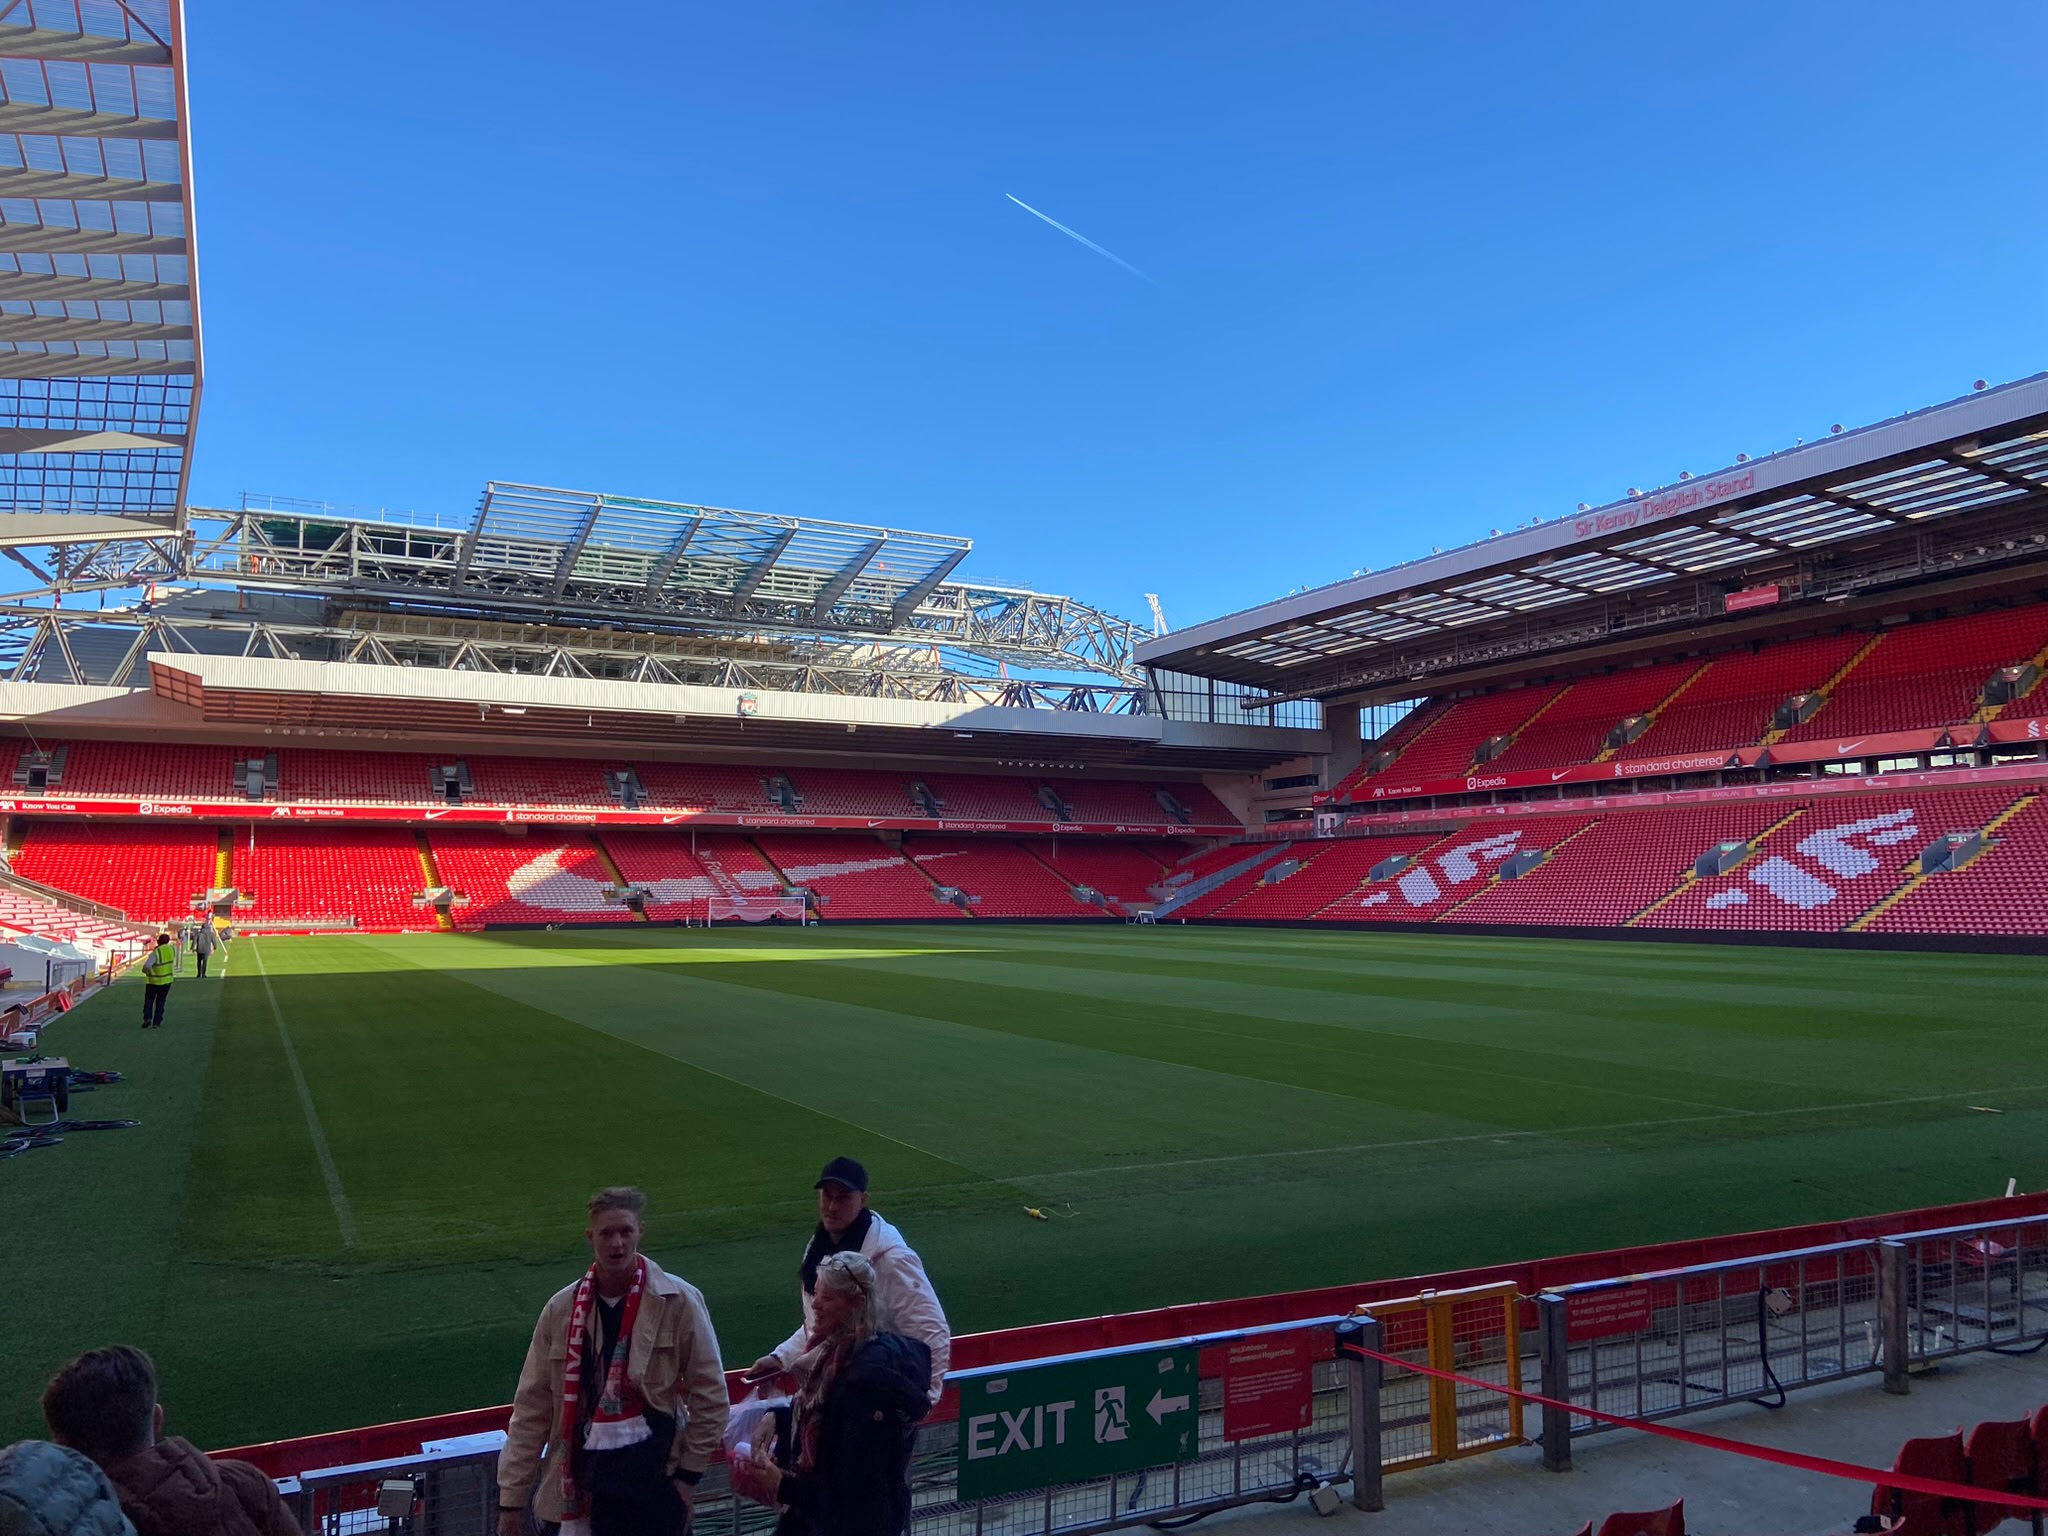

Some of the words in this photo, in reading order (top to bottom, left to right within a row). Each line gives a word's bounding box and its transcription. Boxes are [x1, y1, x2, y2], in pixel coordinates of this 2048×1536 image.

[1574, 521, 1593, 538] Sir
[1595, 508, 1641, 532] Kenny
[1642, 489, 1702, 518] Dalglish
[1705, 471, 1755, 501] Stand
[1625, 762, 1670, 774] standard
[1672, 755, 1723, 769] chartered
[1477, 776, 1506, 788] Expedia
[22, 802, 44, 810] Know
[153, 805, 192, 815] Expedia
[271, 807, 291, 816] AXA
[317, 808, 330, 816] You
[516, 813, 555, 821] standard
[556, 813, 596, 821] chartered
[779, 818, 816, 826] chartered
[1060, 824, 1083, 832] Expedia
[968, 1400, 1075, 1460] EXIT
